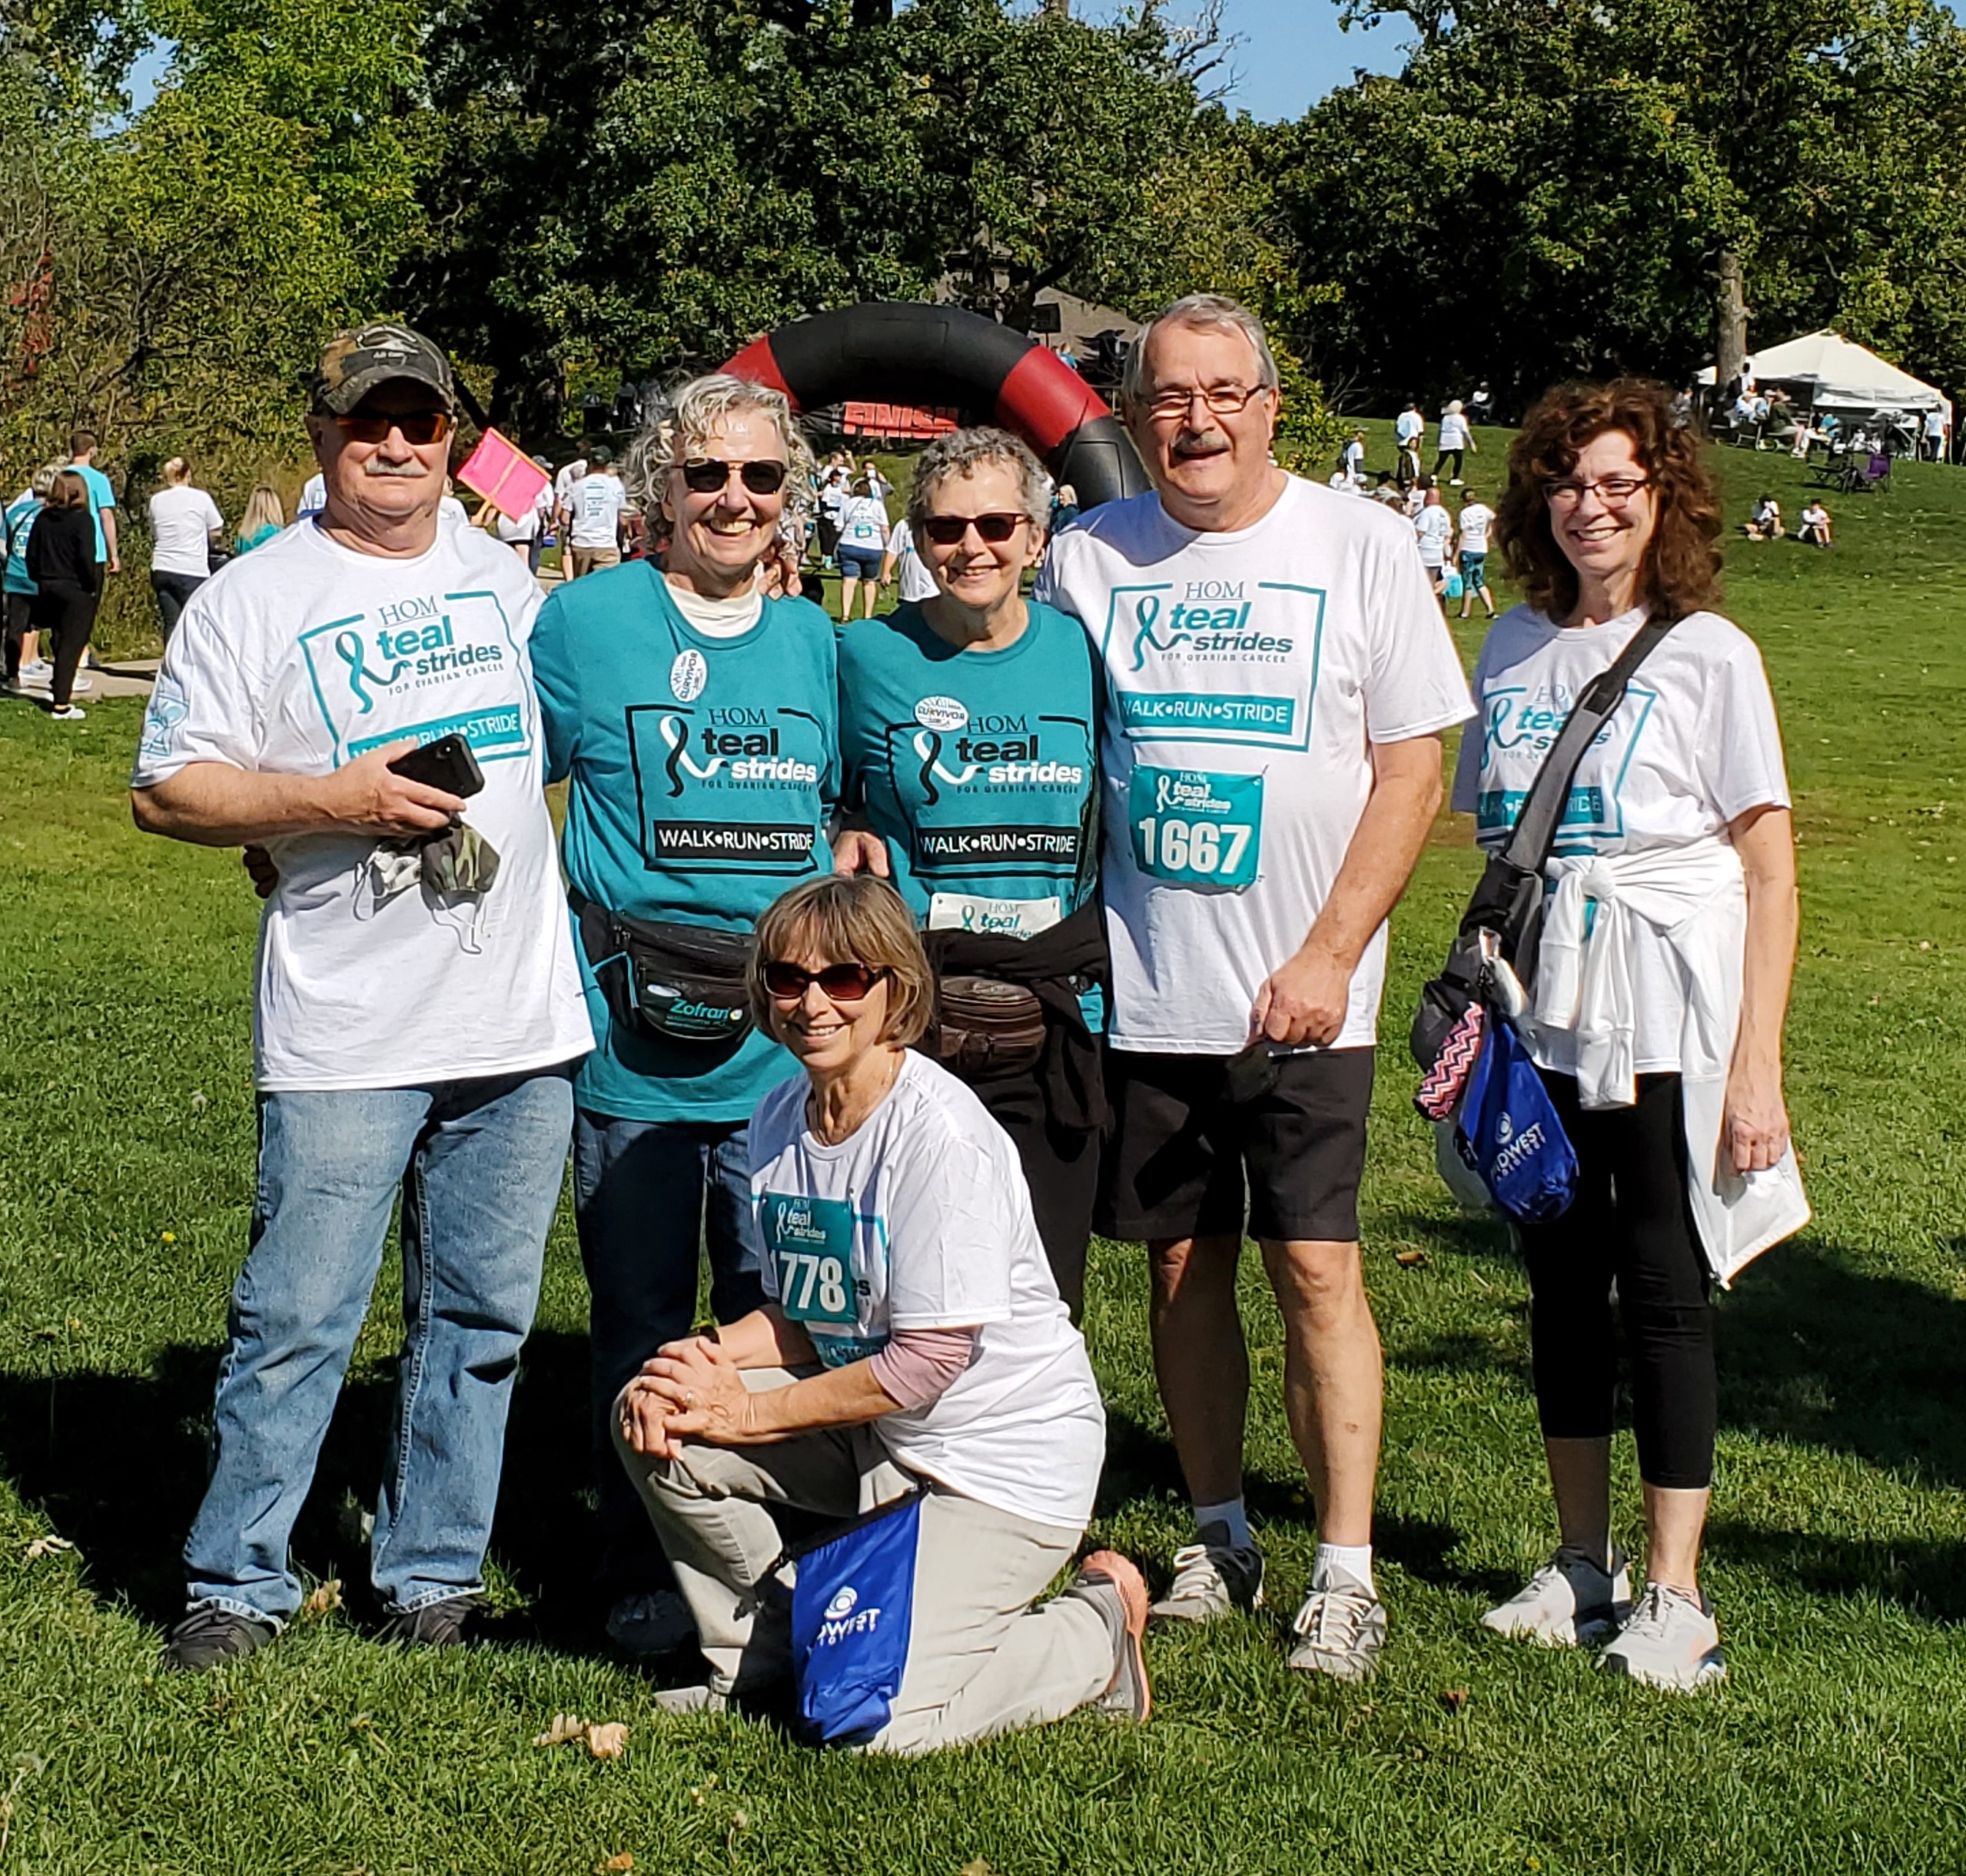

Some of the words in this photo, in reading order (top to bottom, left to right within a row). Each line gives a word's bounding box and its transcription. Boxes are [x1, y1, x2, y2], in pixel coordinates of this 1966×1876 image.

[843, 401, 958, 440] FINISH
[1184, 580, 1244, 599] HOM
[378, 596, 438, 626] HOM
[1169, 602, 1252, 630] teal
[376, 615, 455, 660] teal
[1193, 632, 1294, 653] strides
[417, 643, 503, 676] strides
[1161, 653, 1181, 662] FOR
[1187, 653, 1236, 662] OVARIAN
[1242, 654, 1287, 664] CANCER
[389, 682, 410, 696] FOR
[415, 672, 461, 689] OVARIAN
[708, 708, 768, 726] HOM
[1174, 702, 1212, 718] RUN
[1221, 704, 1288, 723] STRIDE
[467, 712, 518, 739] STRIDE
[966, 714, 1028, 734] HOM
[701, 727, 779, 756] teal
[955, 735, 1038, 763] teal
[731, 758, 817, 782] strides
[988, 761, 1083, 785] strides
[702, 780, 722, 789] FOR
[957, 785, 978, 794] FOR
[1173, 781, 1212, 799] teal
[658, 828, 716, 848] WALK
[722, 831, 761, 850] RUN
[980, 834, 1017, 852] RUN
[1026, 834, 1077, 852] STRIDE
[1138, 817, 1253, 875] 1667
[989, 902, 1019, 914] HOM
[981, 912, 1021, 928] teal
[669, 998, 730, 1020] Zofran
